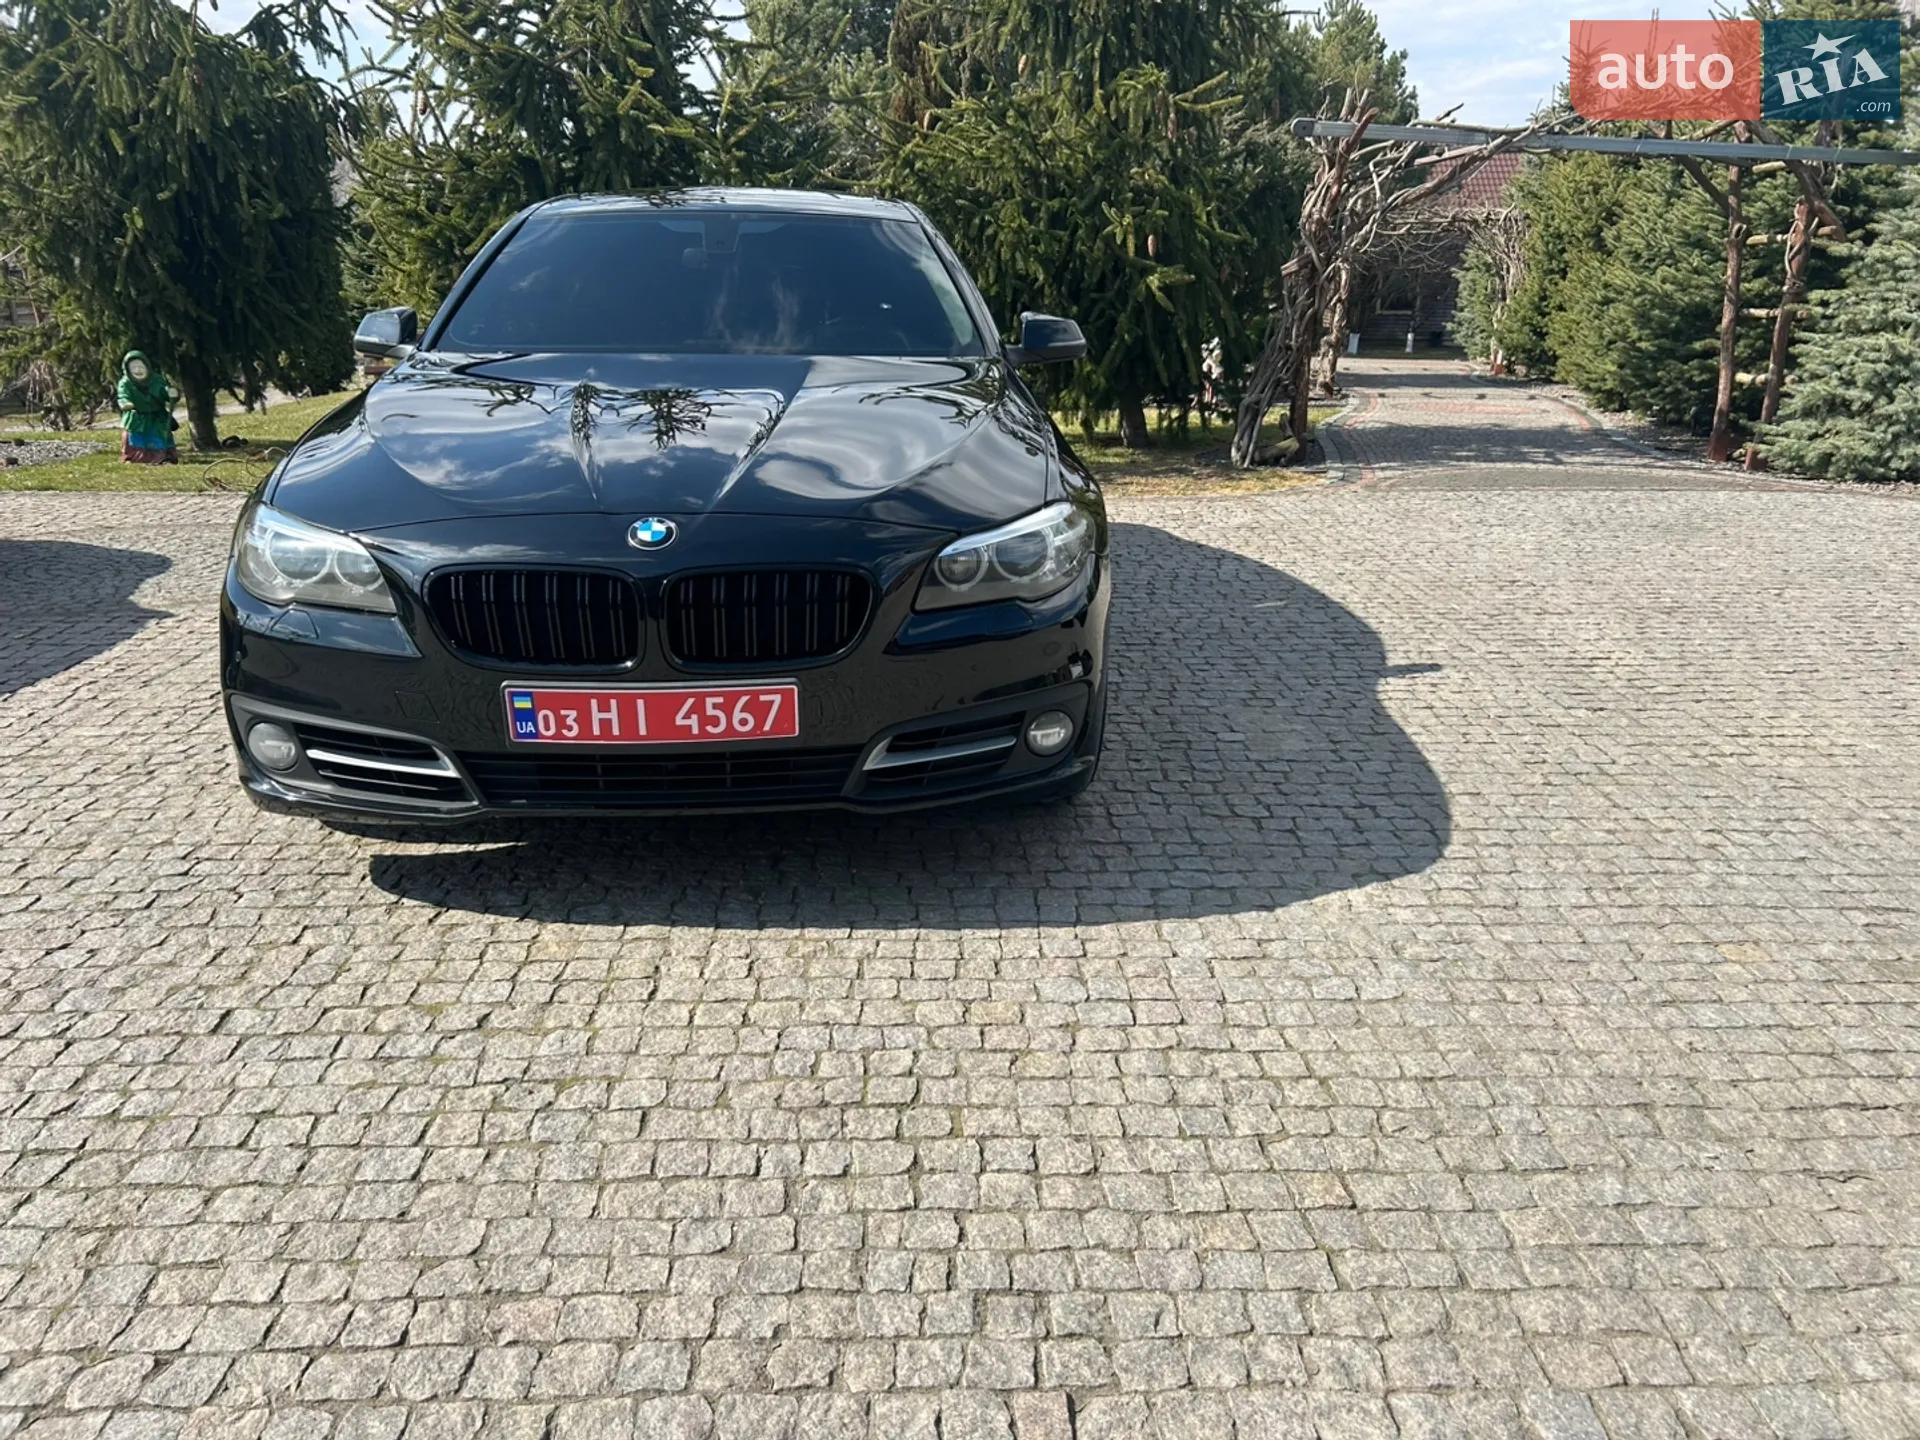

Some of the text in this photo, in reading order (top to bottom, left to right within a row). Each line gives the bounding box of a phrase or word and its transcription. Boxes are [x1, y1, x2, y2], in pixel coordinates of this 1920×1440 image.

[517, 722, 535, 733] UA
[538, 694, 782, 737] 03 HI 4567
